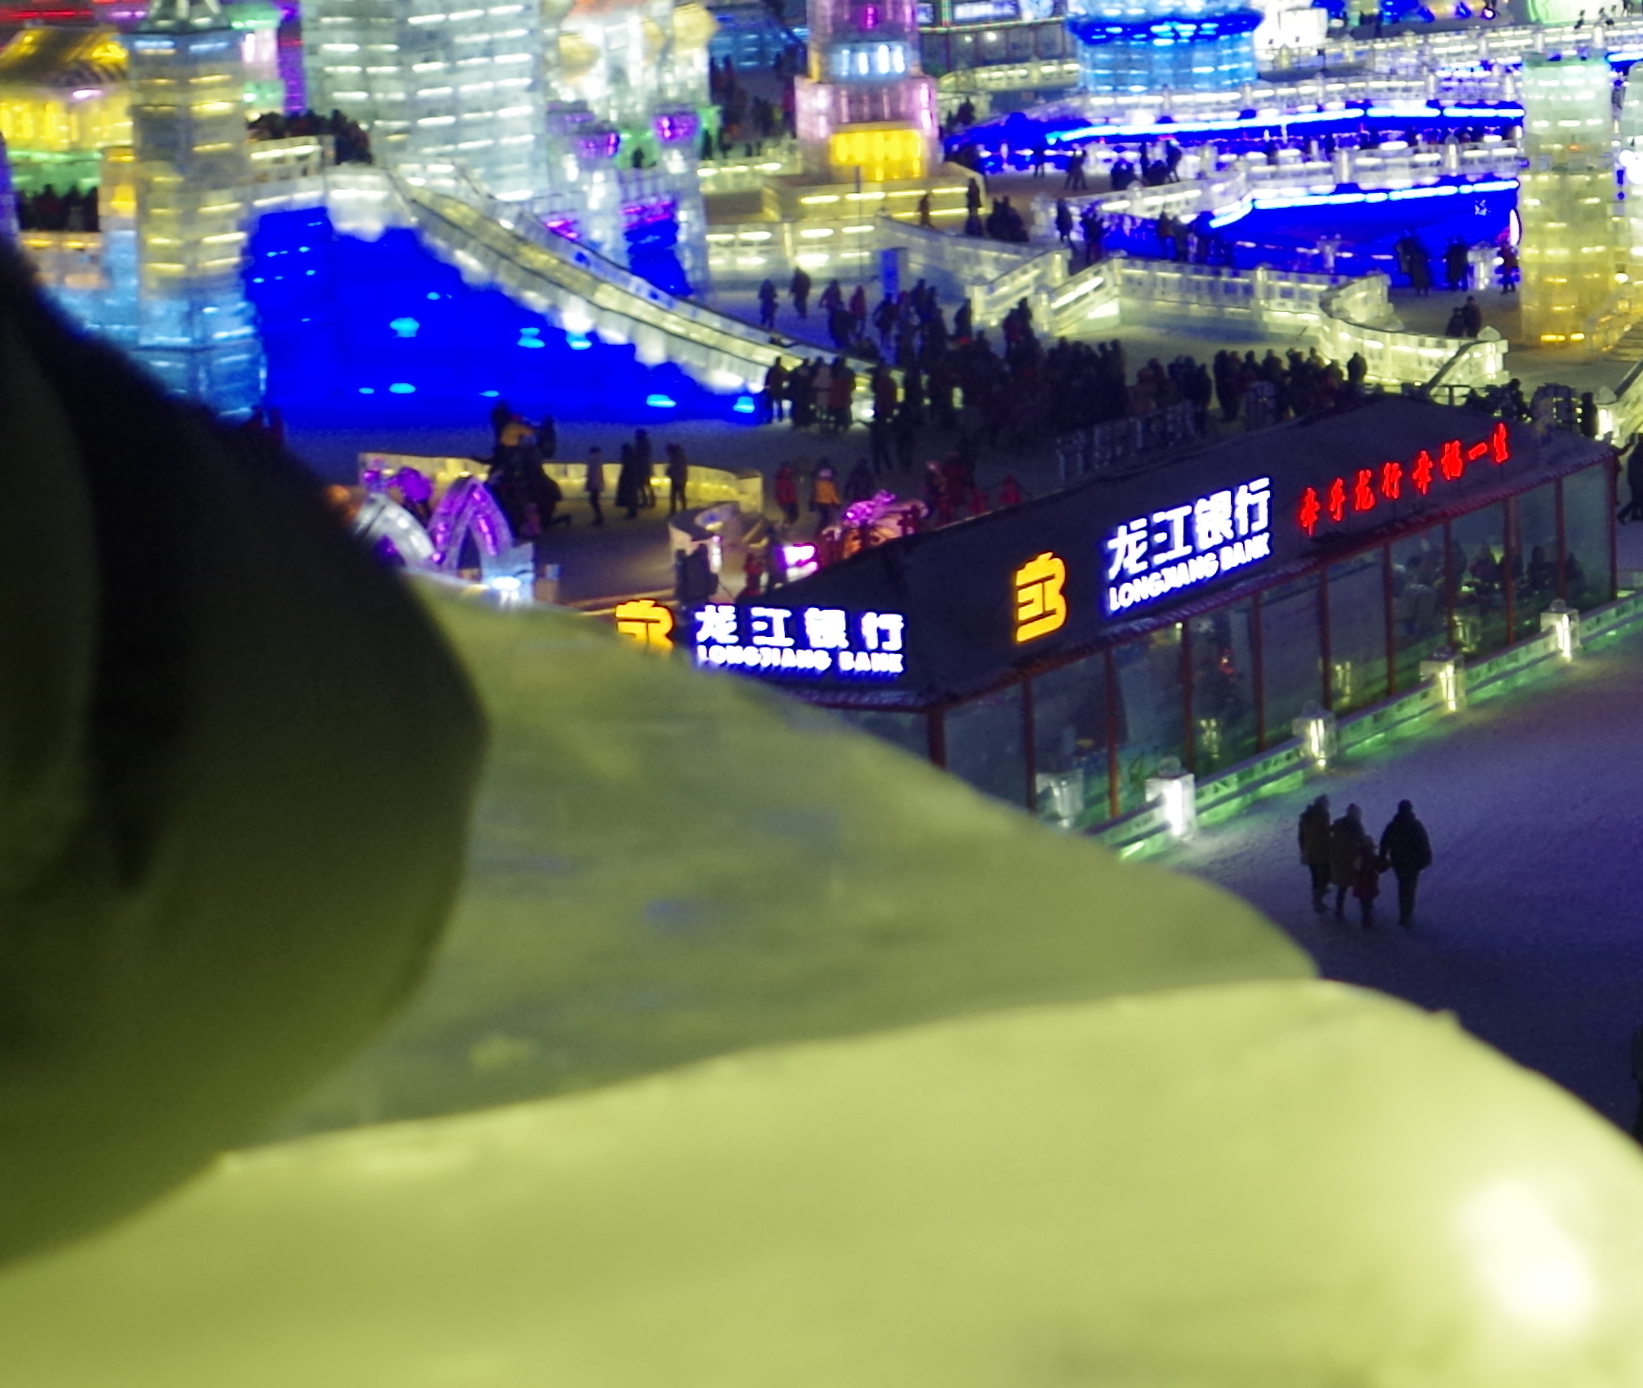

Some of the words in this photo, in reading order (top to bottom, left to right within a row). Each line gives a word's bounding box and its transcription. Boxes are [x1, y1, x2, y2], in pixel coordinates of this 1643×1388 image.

[1107, 477, 1271, 580] 龙江银行
[1109, 552, 1219, 611] LONGJIANG
[1219, 532, 1271, 571] BANK
[694, 604, 905, 652] 龙江银行
[697, 645, 832, 672] LONGJIANG
[839, 651, 905, 674] BANK
